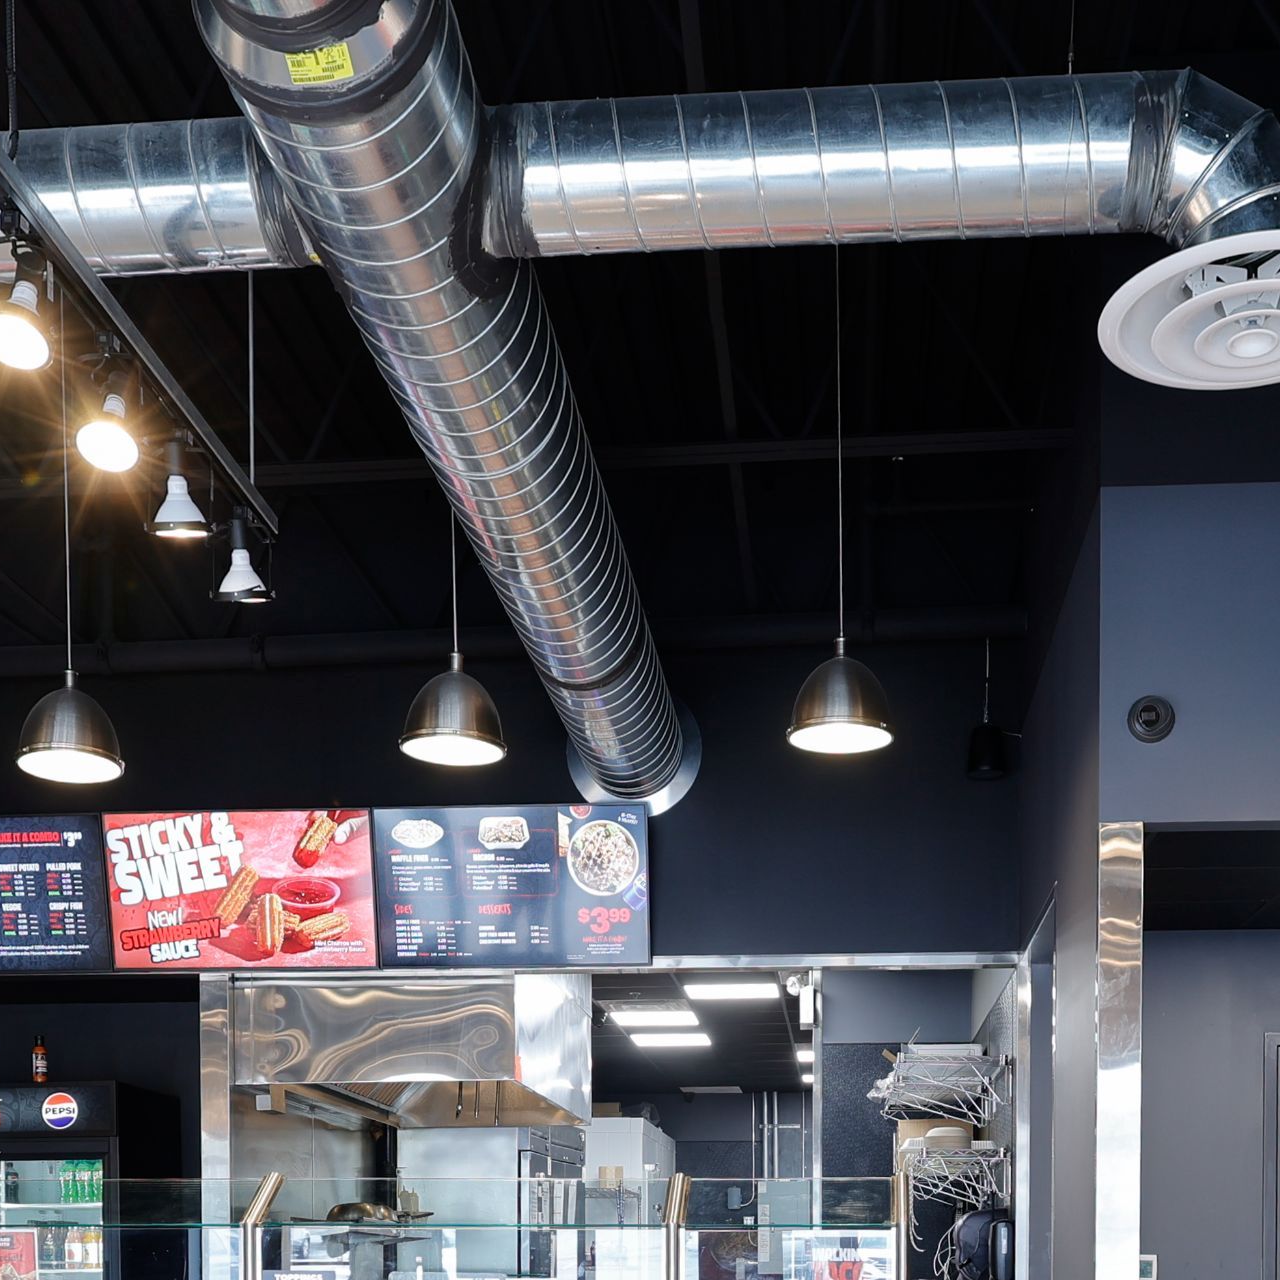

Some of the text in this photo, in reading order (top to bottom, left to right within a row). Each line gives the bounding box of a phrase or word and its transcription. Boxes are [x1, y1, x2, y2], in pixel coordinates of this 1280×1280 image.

[29, 831, 59, 842] COMBO
[106, 813, 204, 863] STICKY
[113, 840, 245, 906] SWEET
[147, 907, 184, 930] NEW!
[394, 904, 412, 915] SIDES
[478, 904, 512, 914] DESSERTS
[120, 916, 220, 951] STRAWBERRY
[150, 940, 200, 963] SAUCE
[44, 1107, 75, 1115] PEPSI
